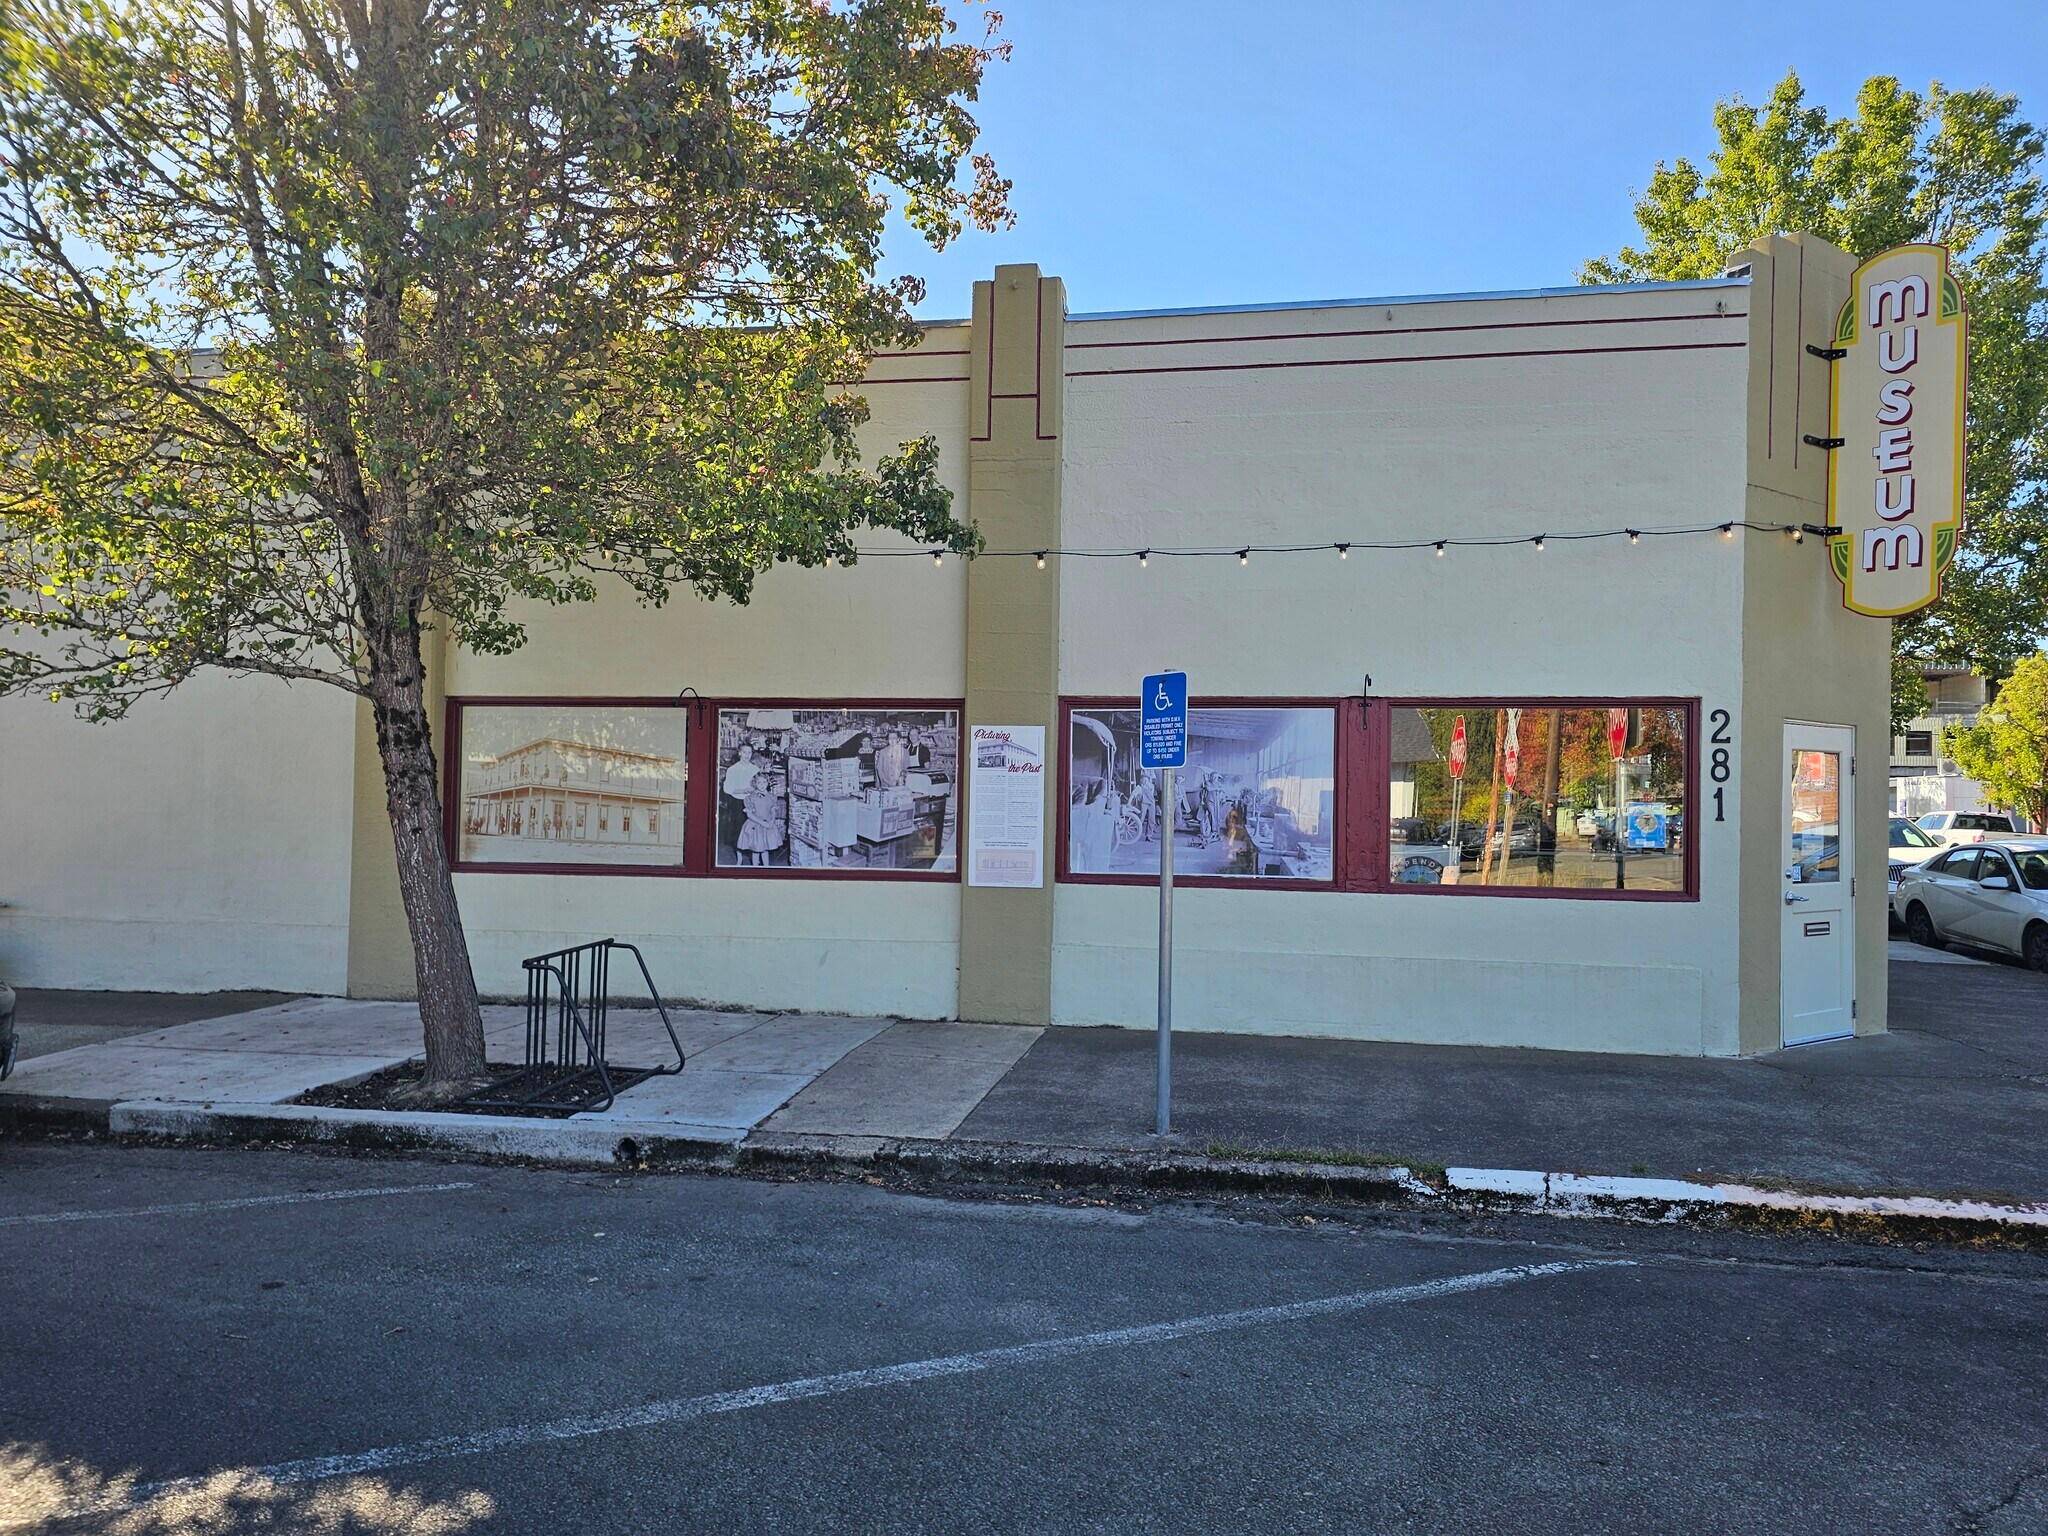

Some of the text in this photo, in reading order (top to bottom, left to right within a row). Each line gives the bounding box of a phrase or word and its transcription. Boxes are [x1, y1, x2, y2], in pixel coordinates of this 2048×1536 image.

[974, 728, 1011, 744] Picturing
[1007, 762, 1042, 774] the Past
